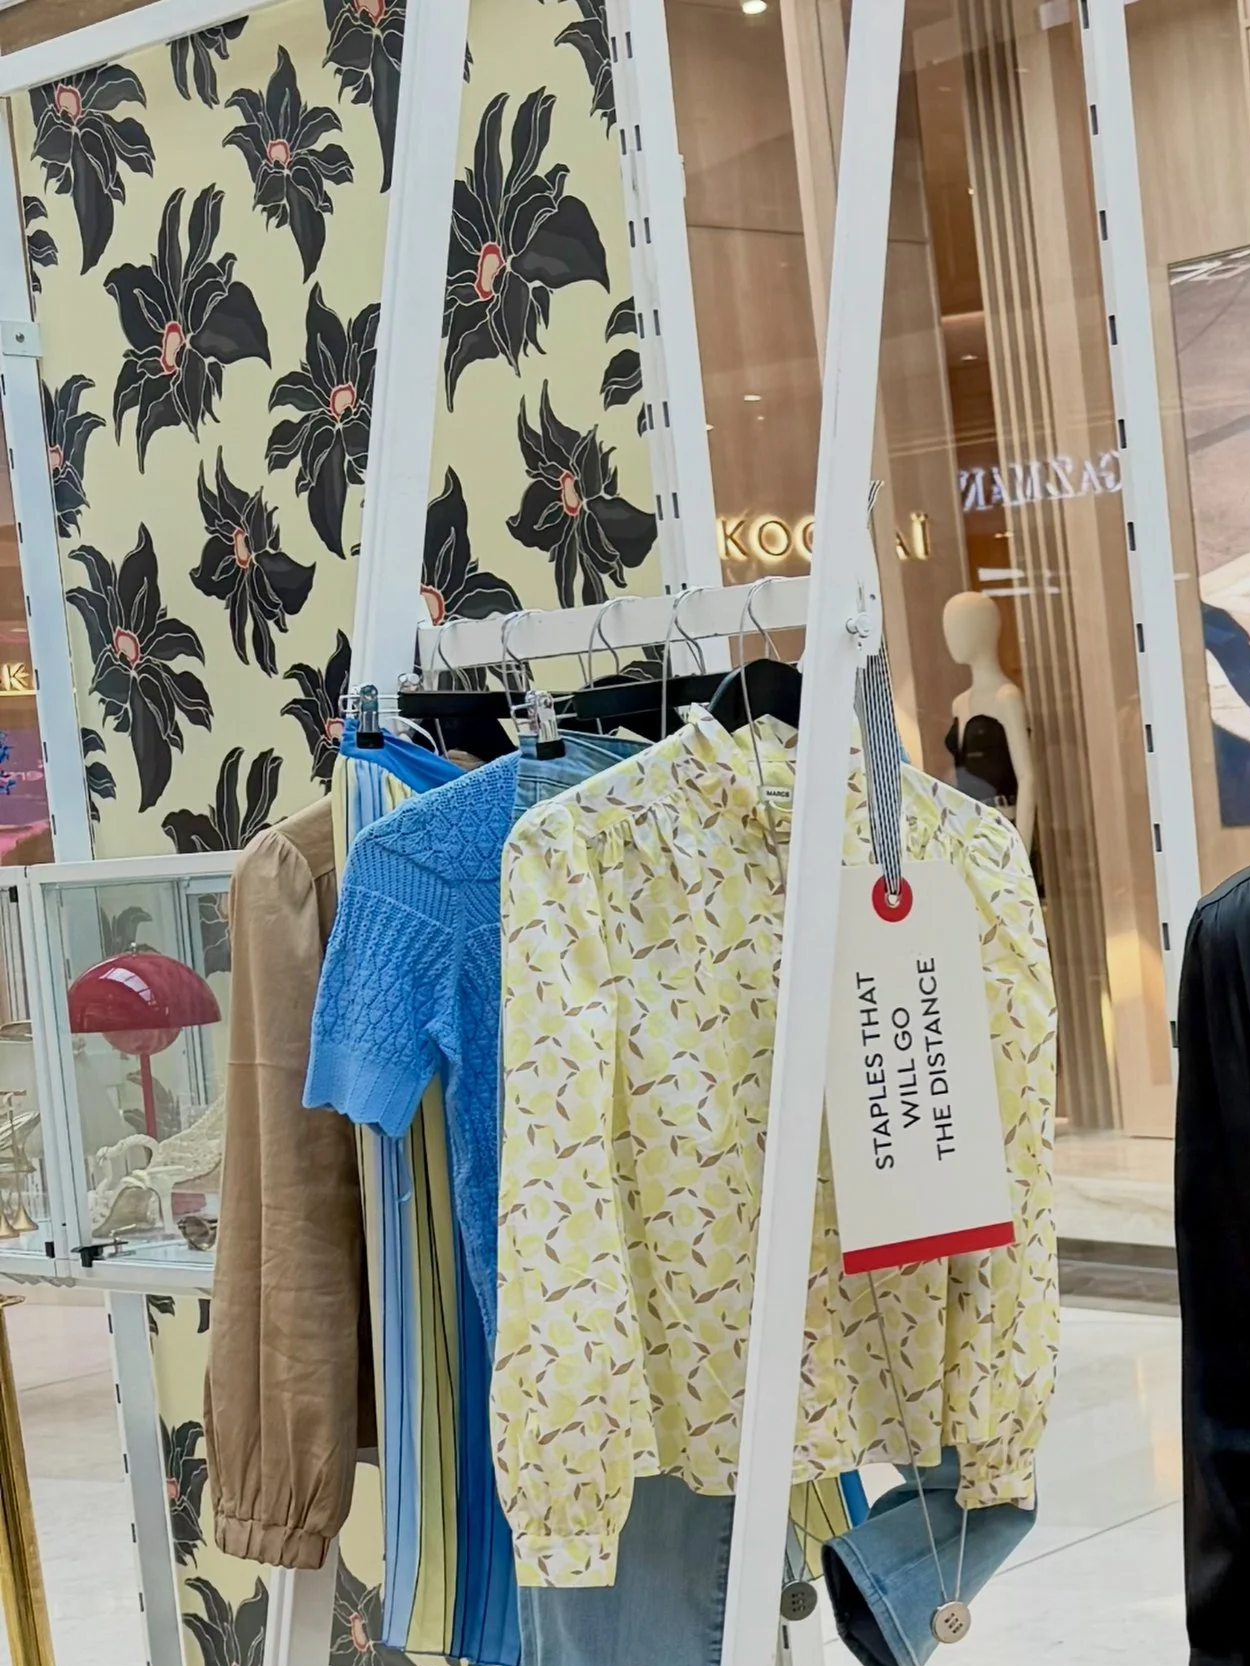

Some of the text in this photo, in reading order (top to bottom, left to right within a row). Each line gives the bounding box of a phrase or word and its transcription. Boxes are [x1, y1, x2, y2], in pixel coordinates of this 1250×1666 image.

[719, 510, 931, 559] KOÏ
[855, 971, 895, 1170] STAPLES THAT
[891, 1007, 921, 1129] WILL GO
[916, 957, 956, 1161] THE DISTANCE
